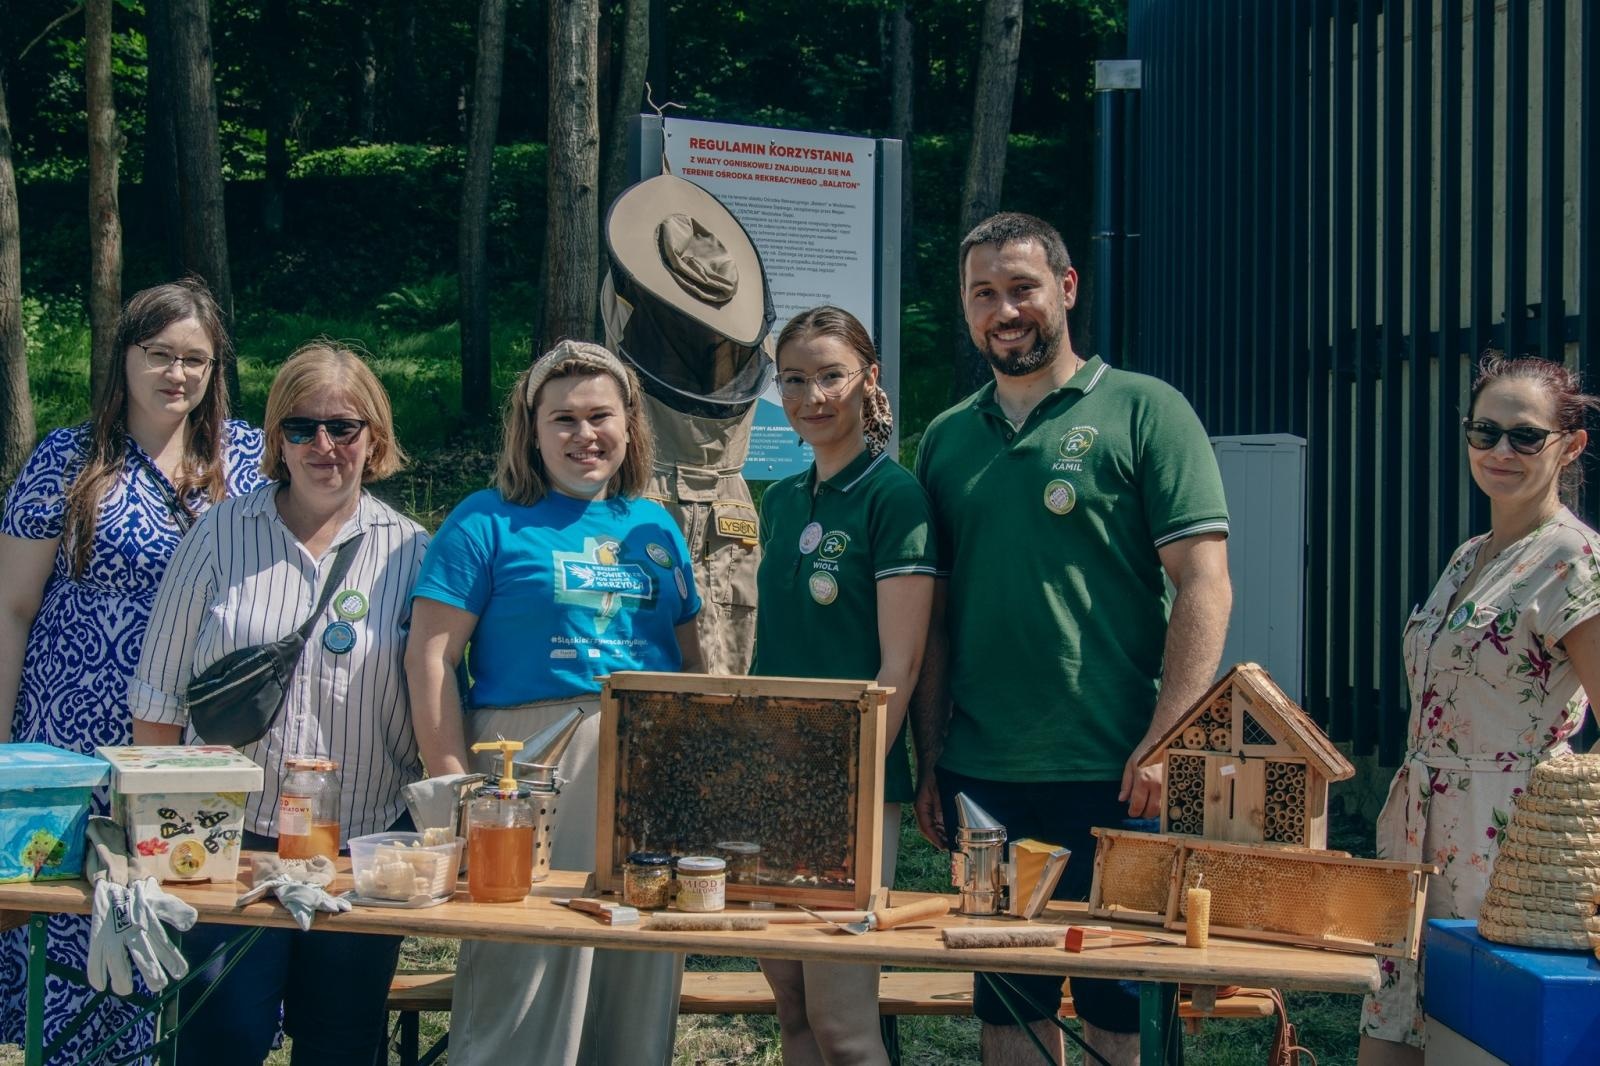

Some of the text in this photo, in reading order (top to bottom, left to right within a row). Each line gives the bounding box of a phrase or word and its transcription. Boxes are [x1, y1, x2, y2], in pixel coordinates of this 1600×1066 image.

[689, 137, 854, 163] REGULAMIN KORZYSTANIA
[682, 167, 714, 177] TERENIE
[715, 170, 753, 180] OŚRODKA
[755, 174, 817, 186] REKREACYJNEGO
[697, 157, 722, 165] WIATY
[723, 159, 773, 170] OGNISKOWEJ
[775, 163, 826, 175] ZNAJDUJĄCEJ
[828, 169, 839, 177] SIĘ
[1052, 462, 1082, 471] KAMIL
[813, 561, 839, 571] WIOLA
